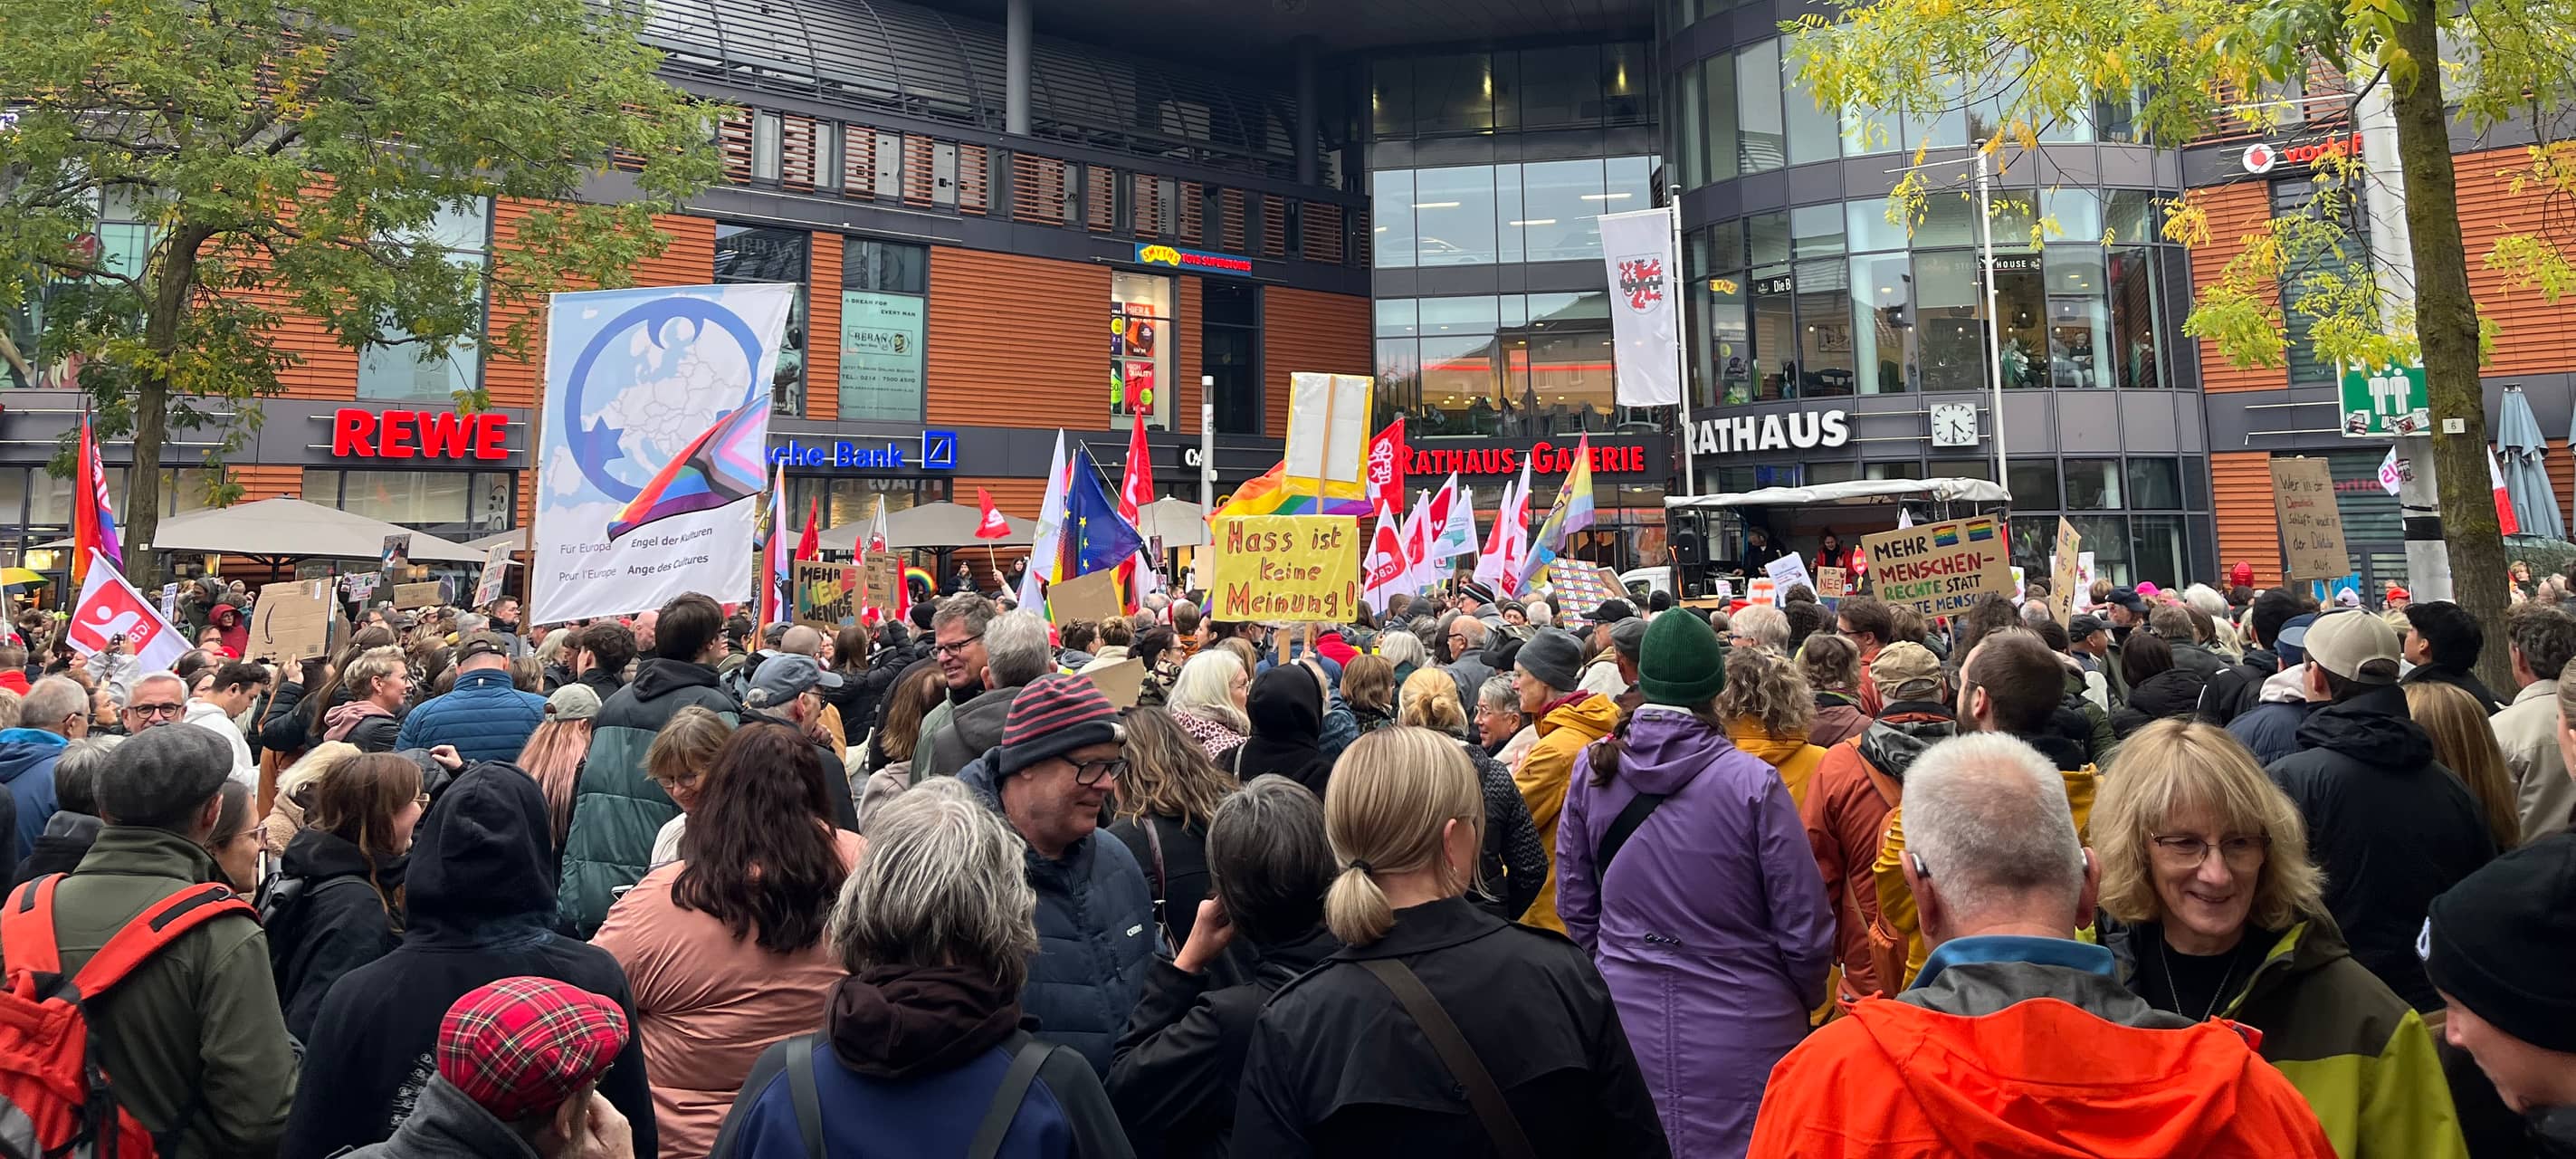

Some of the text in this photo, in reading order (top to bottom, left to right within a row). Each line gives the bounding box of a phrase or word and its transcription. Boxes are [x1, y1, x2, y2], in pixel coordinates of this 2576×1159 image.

[1142, 246, 1179, 264] SMYTHS
[1181, 254, 1201, 265] TOYS
[1997, 260, 2027, 269] HOUSE
[1774, 279, 1785, 292] Die
[333, 408, 509, 459] REWE
[834, 440, 905, 468] Bank
[559, 541, 612, 555] Für Europa
[631, 526, 713, 549] Engel der Kulturen
[1227, 520, 1342, 554] Hass ist
[1874, 535, 1929, 562] MEHR
[558, 567, 616, 582] Pour l'Europe
[627, 553, 709, 577] Ange des Cultures
[1879, 551, 1996, 585] MENSCHEN-
[800, 566, 840, 589] MEHR
[1884, 574, 1982, 601] RECHTE STATT
